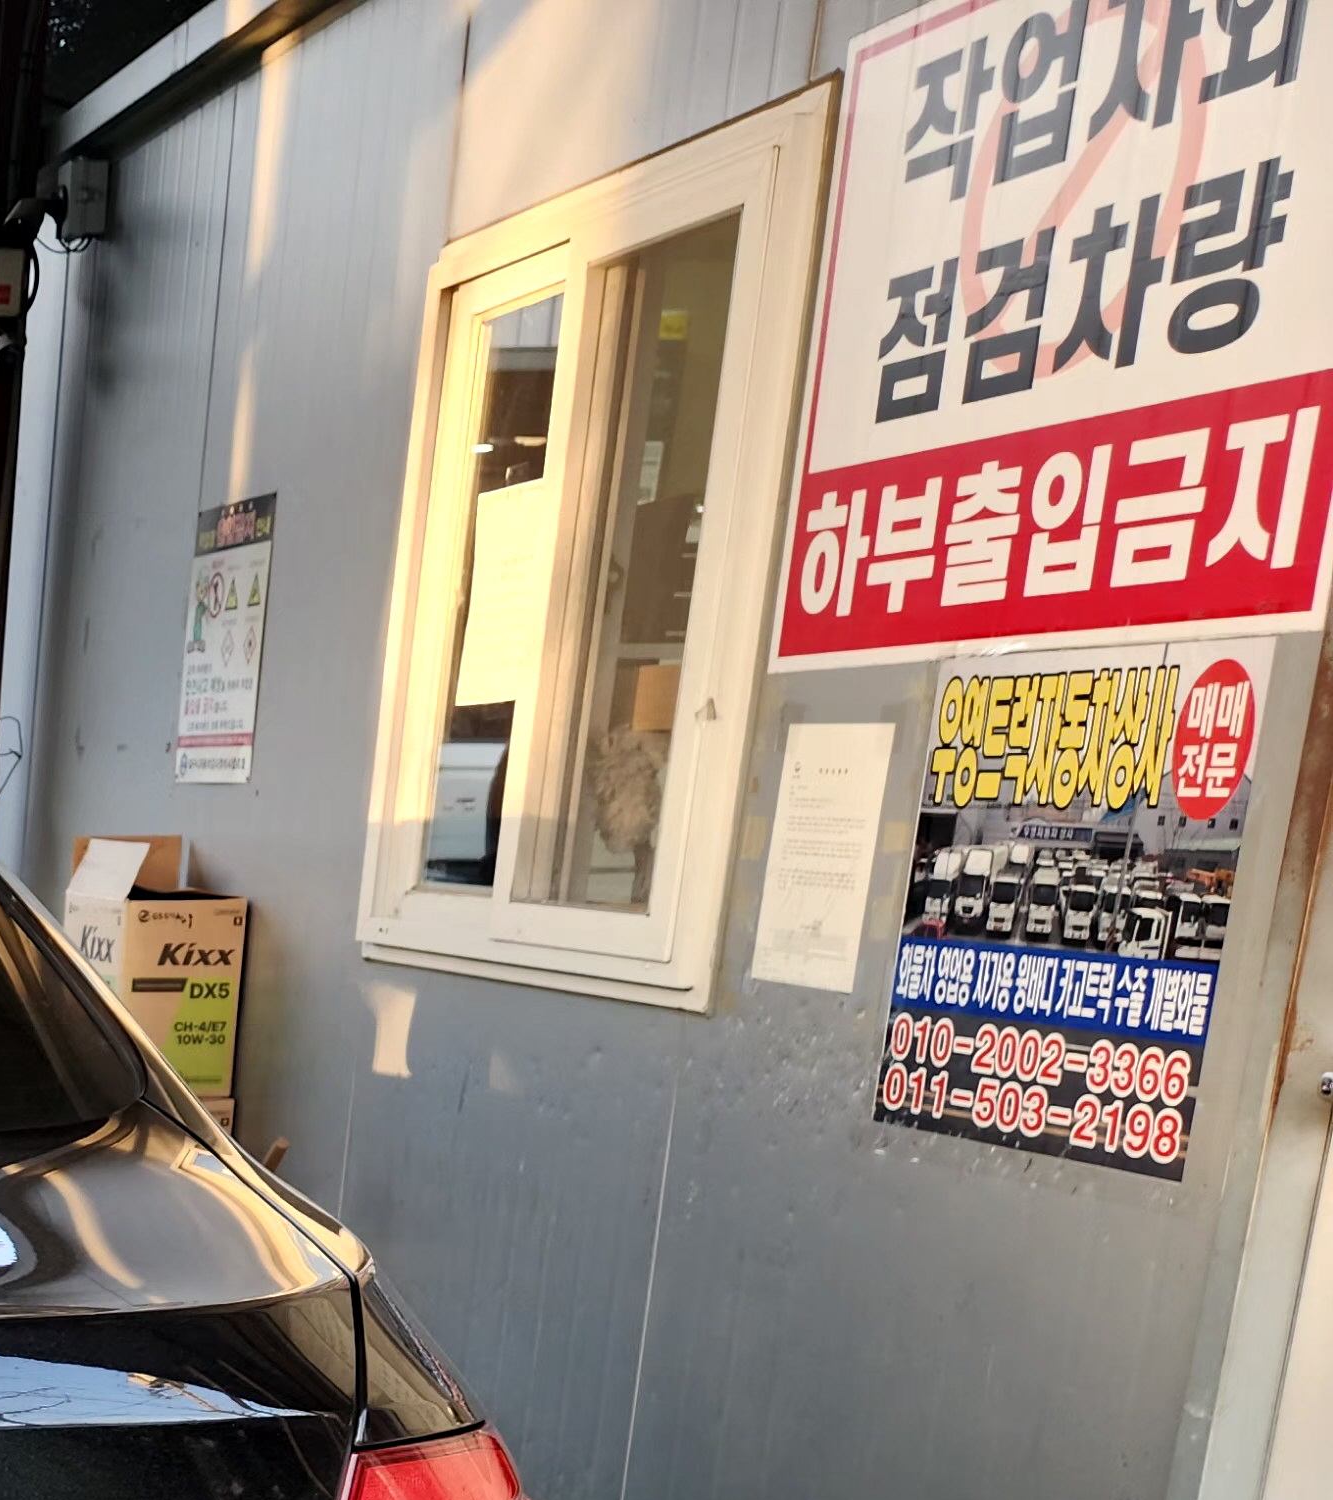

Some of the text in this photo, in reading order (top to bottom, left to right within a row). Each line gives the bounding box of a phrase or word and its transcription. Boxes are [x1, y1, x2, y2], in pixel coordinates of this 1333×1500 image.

[875, 156, 1294, 424] 점검차량
[800, 406, 1321, 617] 하부출입금지
[931, 665, 1181, 809] 우영트럭자동차상사
[1186, 680, 1251, 738] 매매
[1177, 742, 1238, 799] 전문
[80, 924, 116, 963] Kixx
[157, 942, 235, 966] Kixx
[189, 982, 230, 999] DX5
[895, 942, 1213, 1036] 화물차 영업용 자가용 윙바디 카고트럭 수출 개별화물
[174, 1021, 227, 1033] CH-4/E7
[176, 1034, 226, 1045] 10W-30
[889, 1012, 1193, 1103] 010-2002-3366
[882, 1063, 1185, 1164] 011-503-2198
